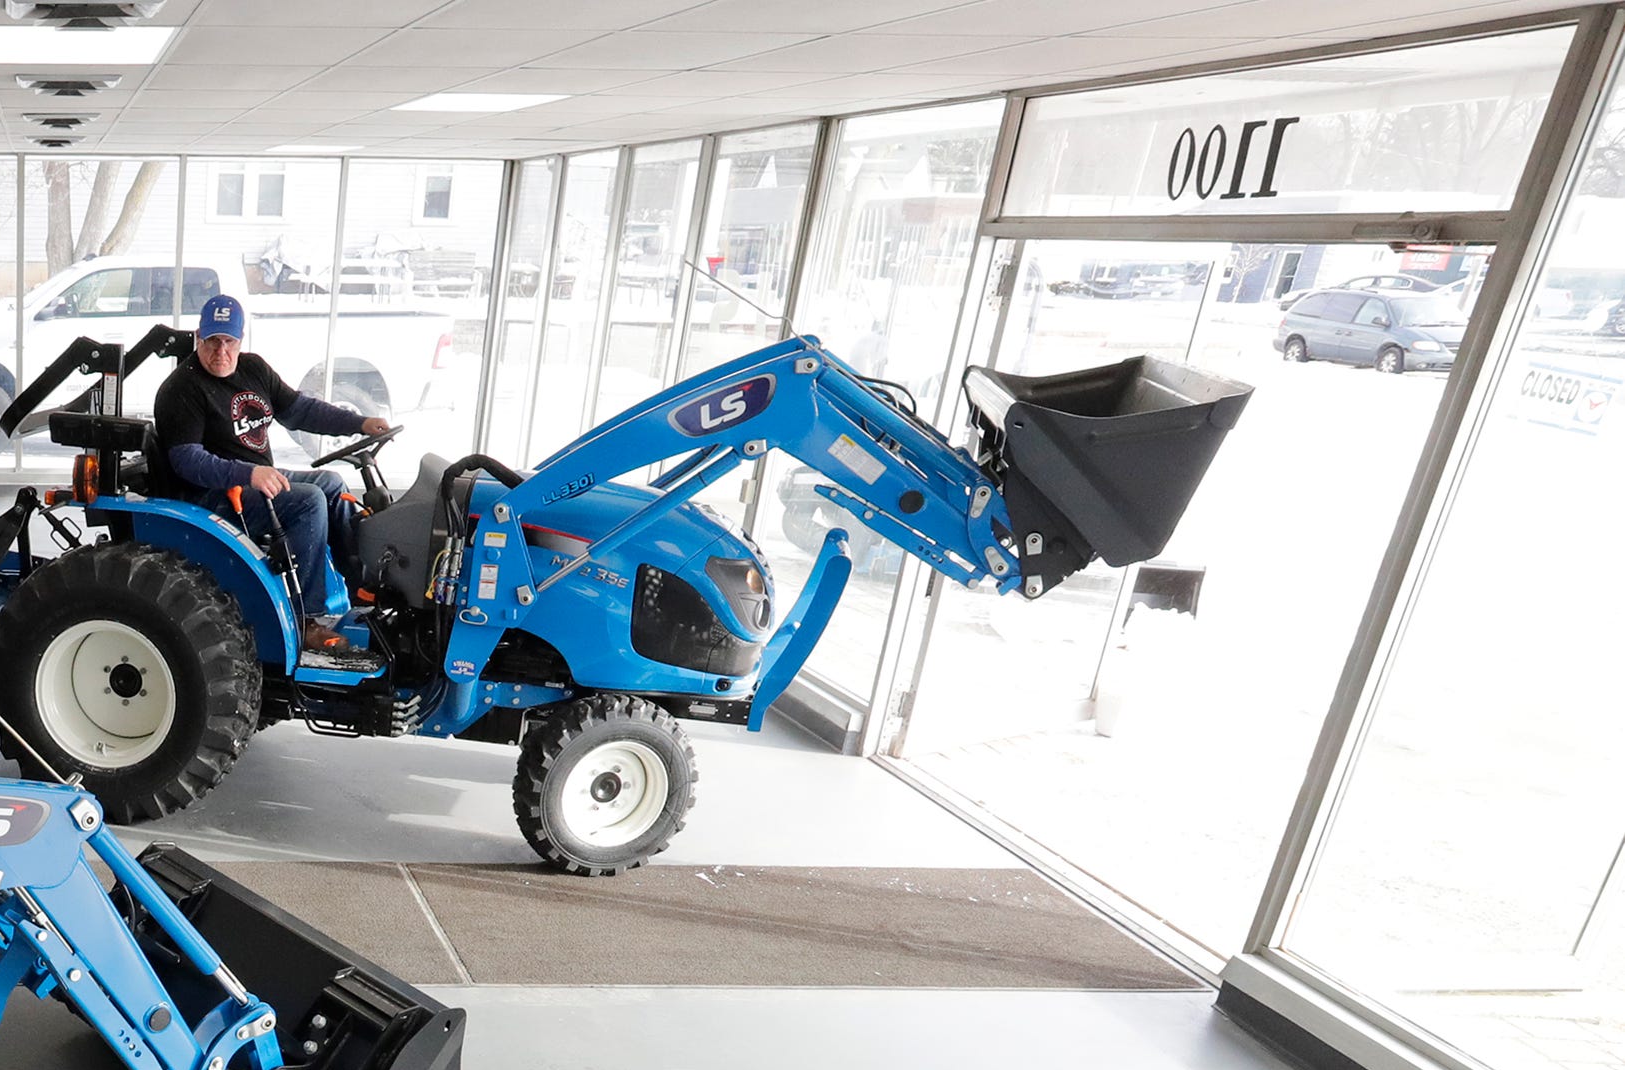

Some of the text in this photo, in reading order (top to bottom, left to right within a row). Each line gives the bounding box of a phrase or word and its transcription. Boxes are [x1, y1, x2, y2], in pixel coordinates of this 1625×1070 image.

[214, 307, 231, 317] LS
[1520, 370, 1581, 405] CLOSED
[700, 390, 747, 430] LS
[541, 472, 596, 506] LL3301
